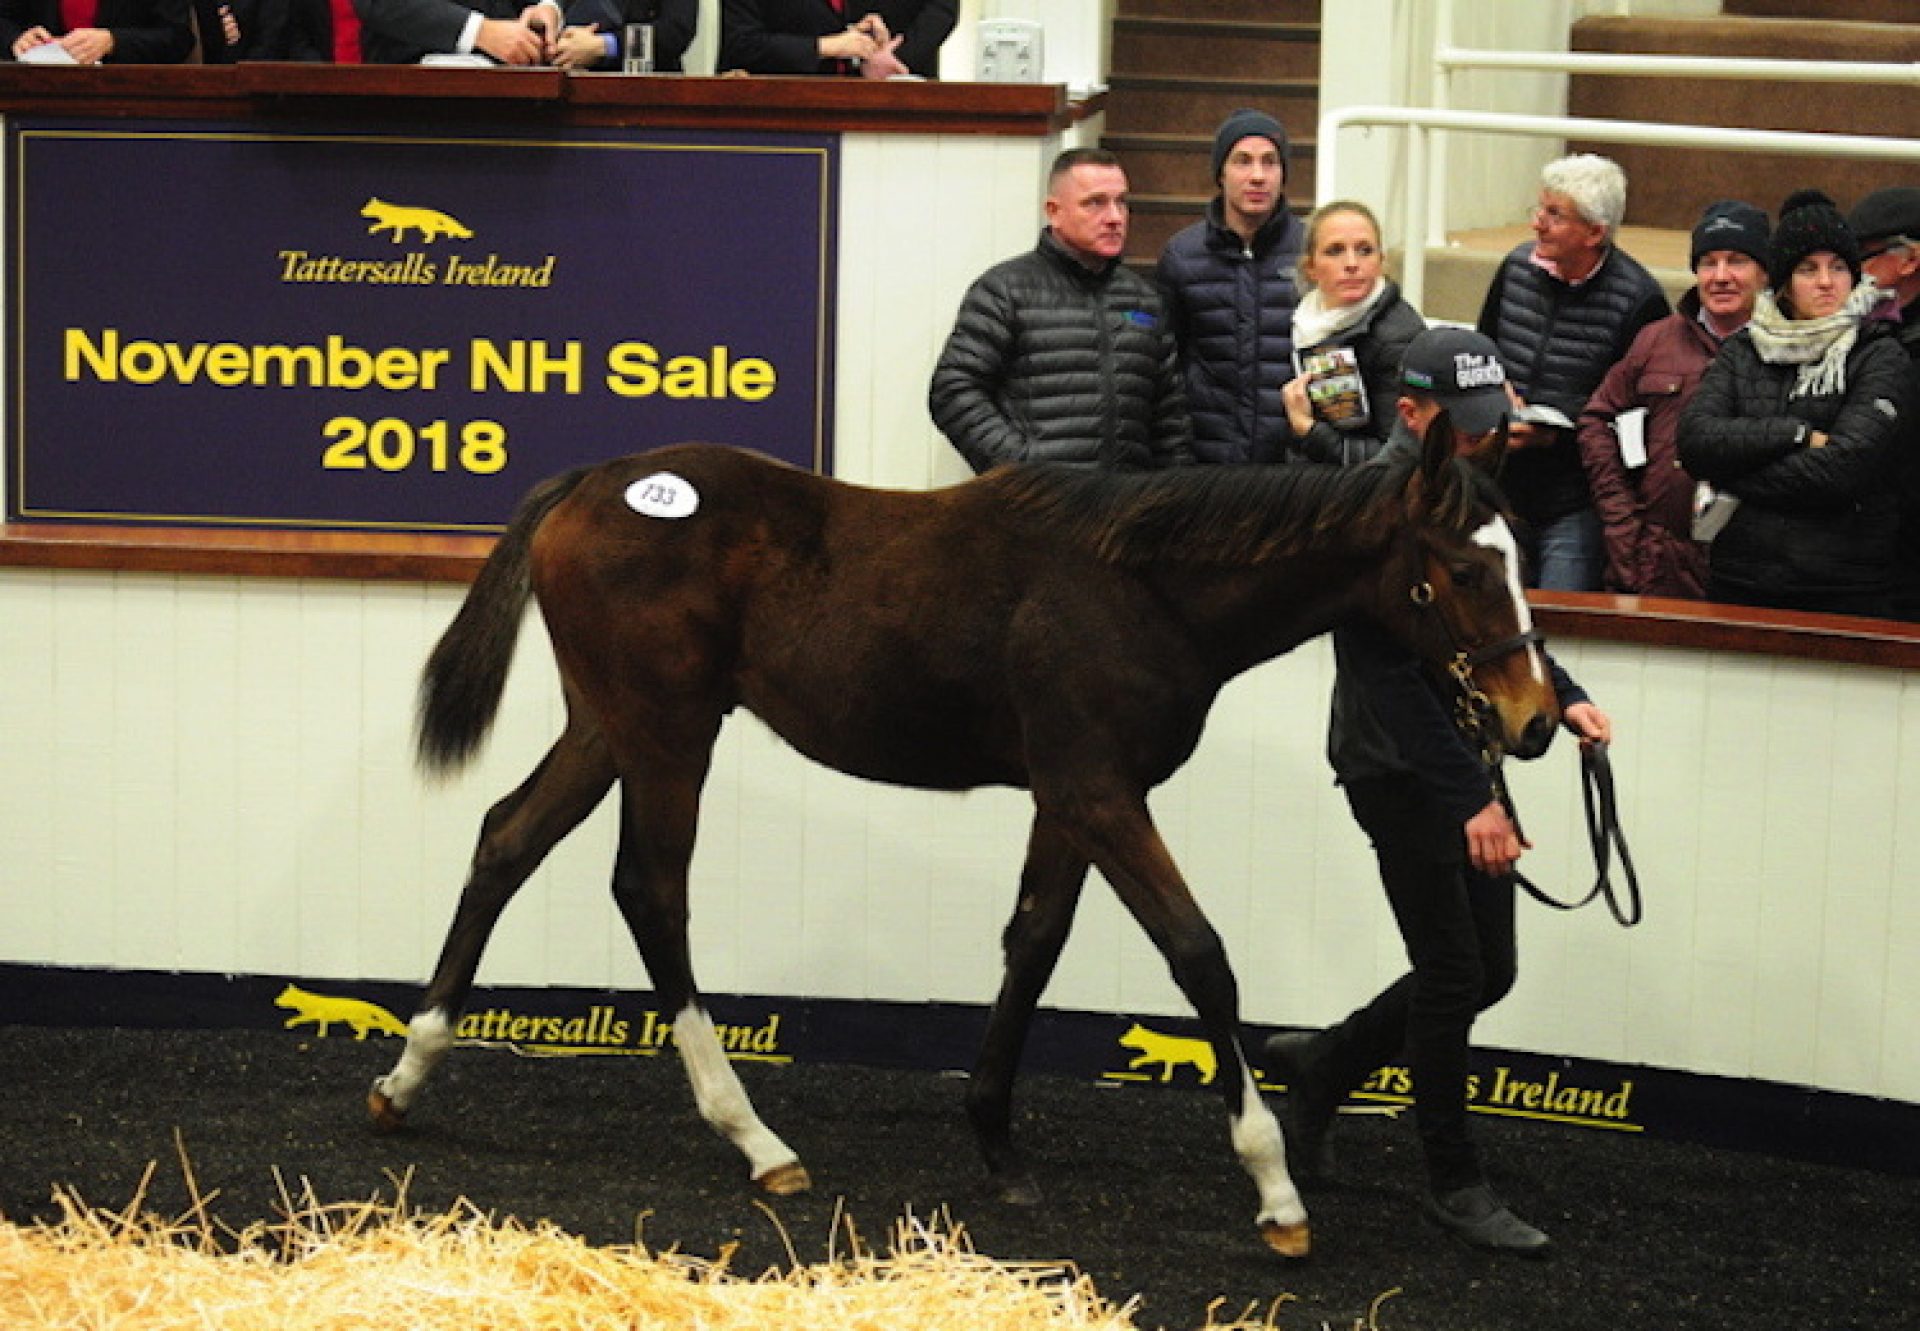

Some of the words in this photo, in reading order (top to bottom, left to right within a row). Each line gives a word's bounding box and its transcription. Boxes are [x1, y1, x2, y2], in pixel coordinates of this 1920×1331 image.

[279, 250, 436, 285] Tattersalls
[443, 255, 556, 288] Ireland
[63, 327, 450, 390] November
[470, 338, 582, 394] NH
[606, 341, 777, 402] Sale
[322, 416, 508, 475] 2018
[640, 484, 677, 506] 733
[455, 1005, 629, 1044] attersalls
[638, 1010, 780, 1052] Irnd
[1488, 1066, 1633, 1119] Ireland
